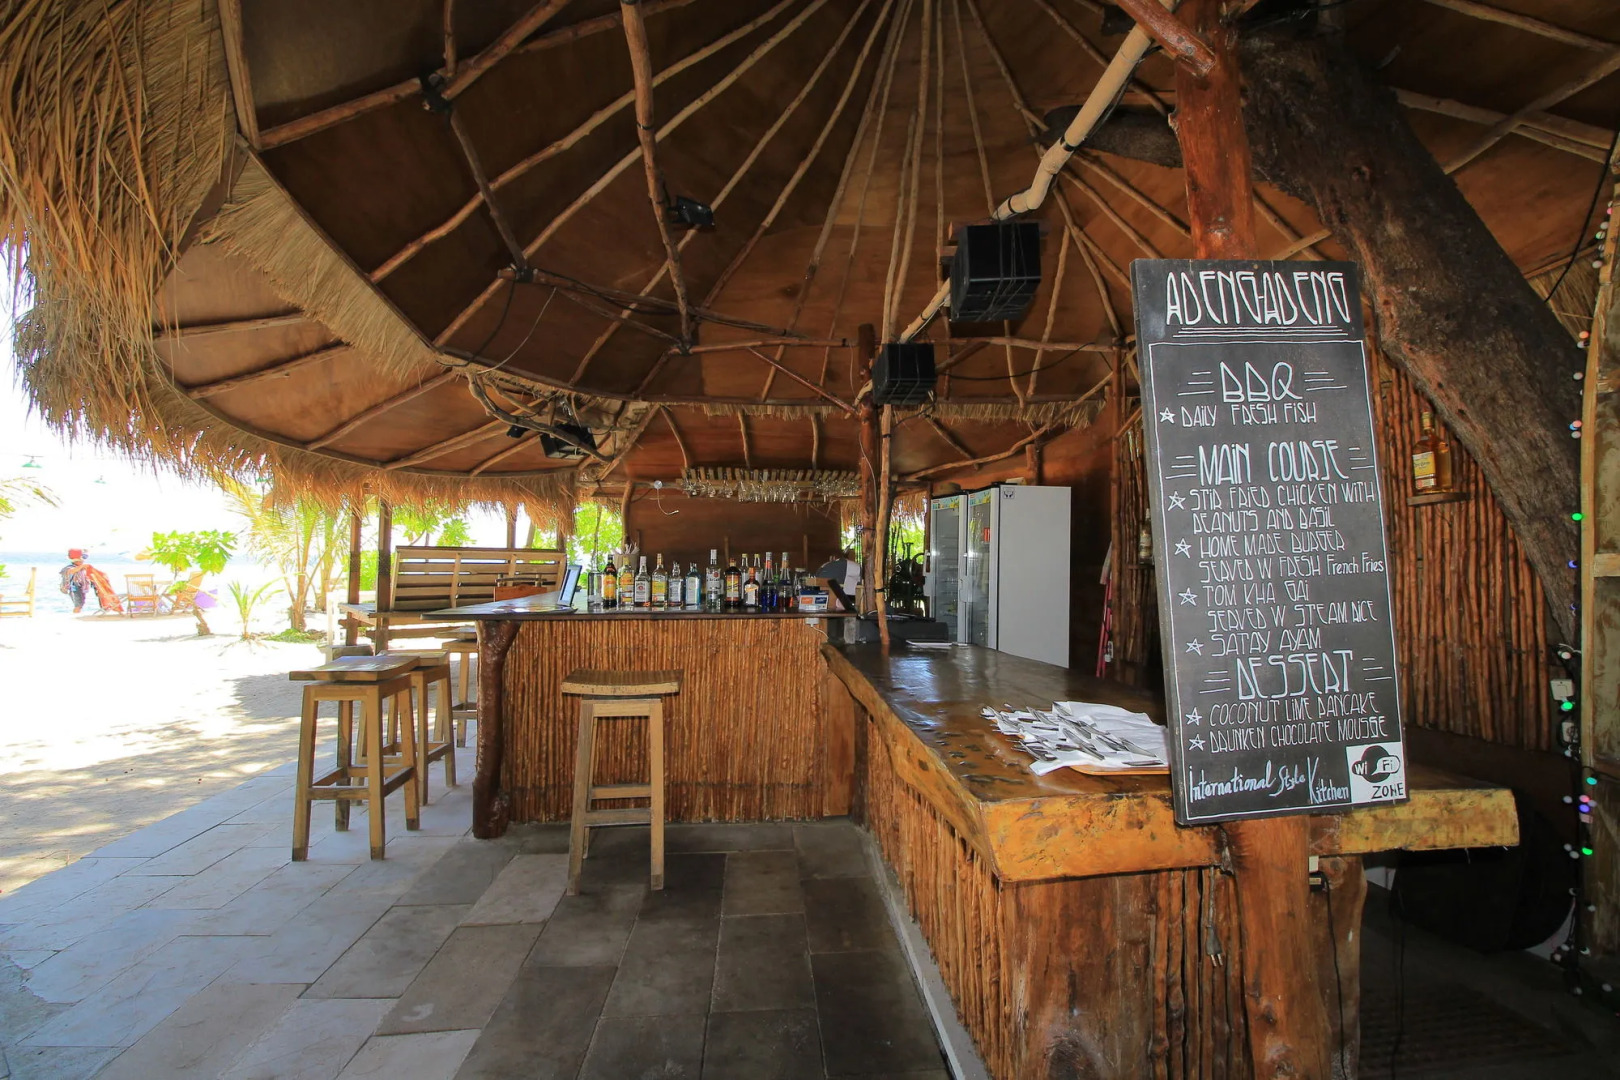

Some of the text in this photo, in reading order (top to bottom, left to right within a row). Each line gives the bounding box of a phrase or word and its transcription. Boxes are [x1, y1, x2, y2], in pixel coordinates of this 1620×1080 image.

[1166, 271, 1351, 325] ADENG-ADENG
[1220, 361, 1303, 403] BBQ
[1231, 404, 1277, 425] FRESH
[1268, 440, 1349, 482] COURSE
[1193, 510, 1258, 534] PEANUTS
[1267, 509, 1293, 530] AND
[1200, 530, 1345, 558] HOME MADE BURGER
[1199, 552, 1384, 583] SERVED W FRESH French Fries
[1203, 585, 1237, 607] TOM
[1244, 582, 1275, 605] KHA
[1208, 609, 1267, 632] SERVED
[1271, 606, 1285, 627] W
[1294, 602, 1348, 627] STEAM
[1211, 628, 1321, 657] SATAY AYAM
[1236, 651, 1353, 701] DESSERT
[1210, 700, 1280, 726] COCONUT
[1318, 692, 1379, 718] PANCAKE
[1210, 716, 1388, 753] DRUNKEN CHOCOLATE MOUSSE
[1307, 757, 1349, 804] Kitchen
[1371, 783, 1404, 800] ZONE
